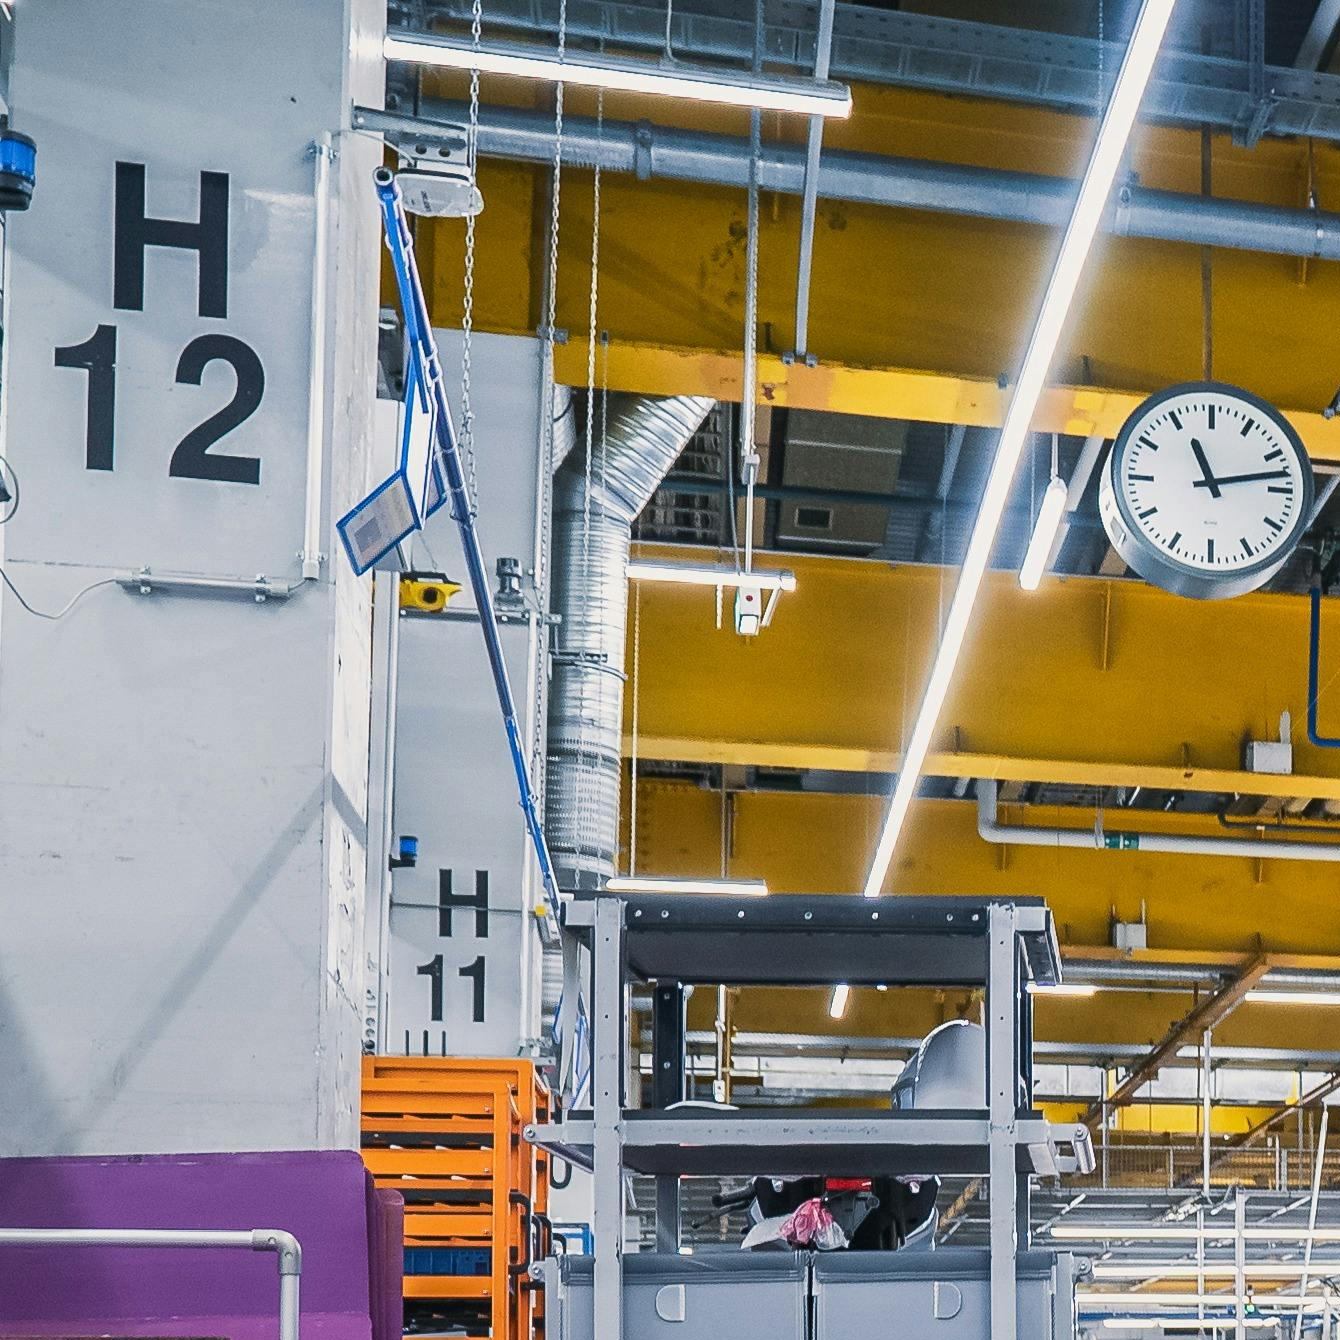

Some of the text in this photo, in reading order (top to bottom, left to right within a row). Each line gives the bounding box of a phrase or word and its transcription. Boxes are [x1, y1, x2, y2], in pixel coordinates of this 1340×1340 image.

[113, 161, 230, 319] H
[54, 324, 266, 485] 12
[438, 868, 489, 939] H
[416, 953, 486, 1023] 11
